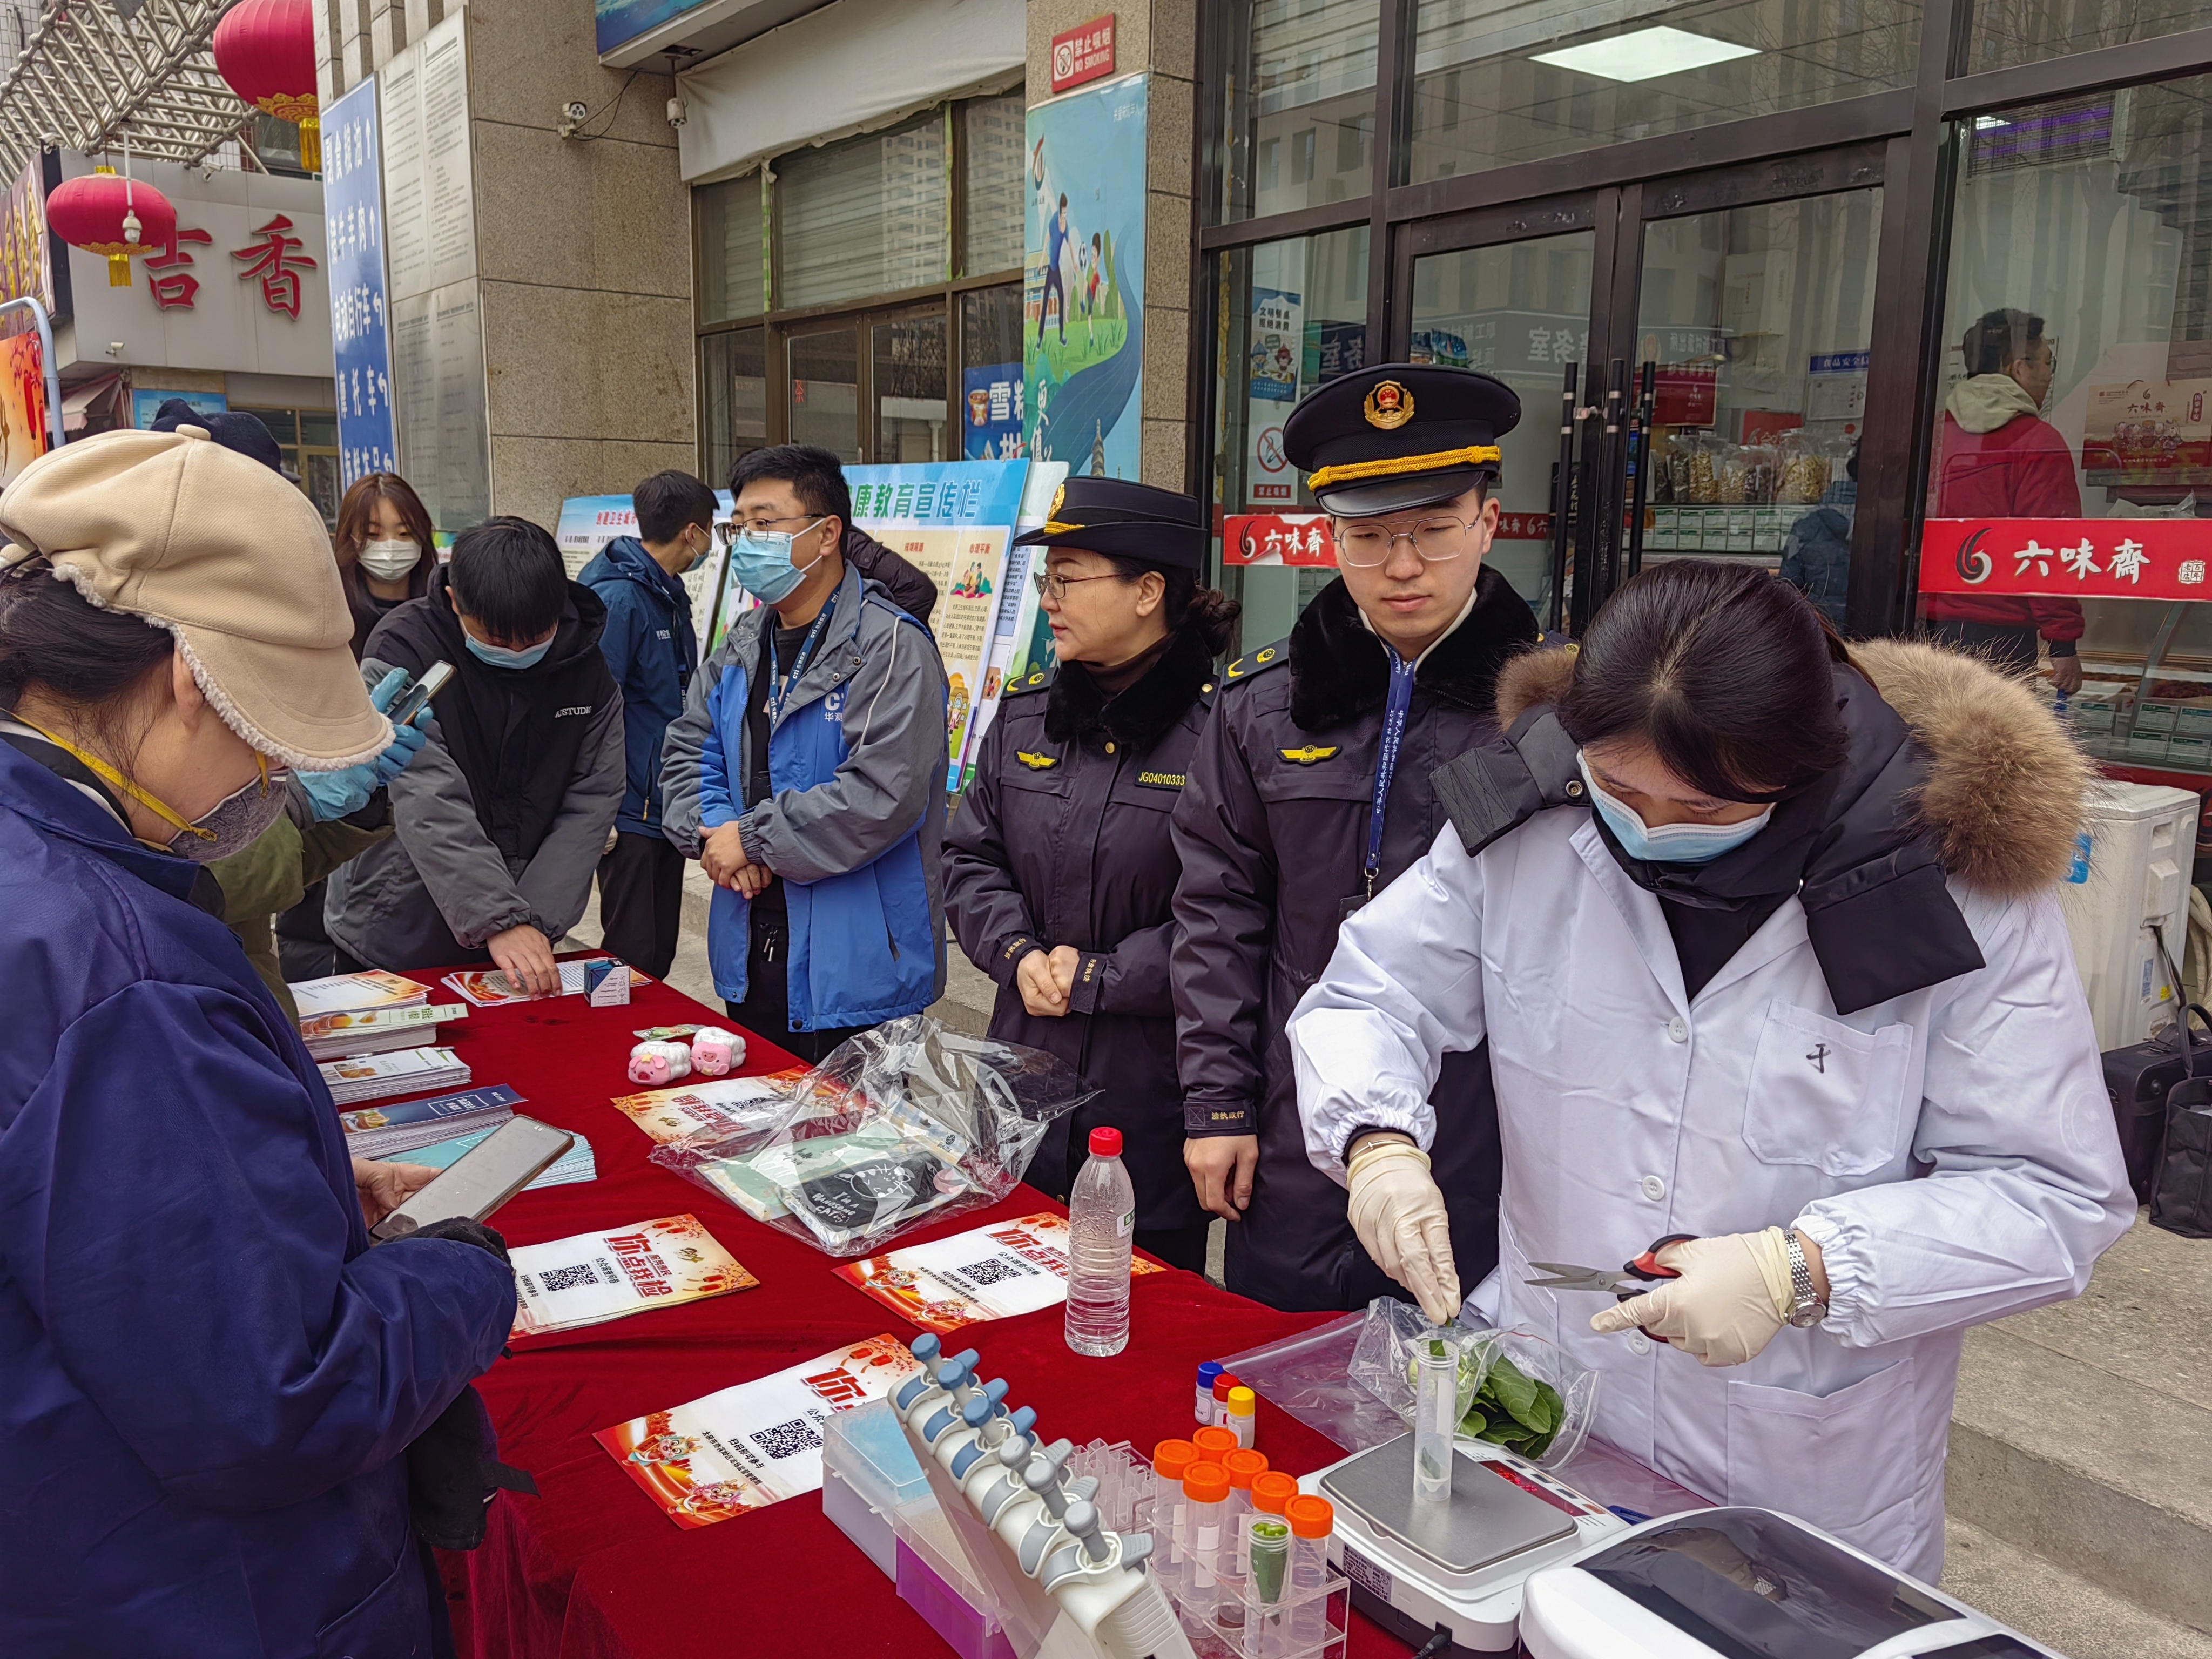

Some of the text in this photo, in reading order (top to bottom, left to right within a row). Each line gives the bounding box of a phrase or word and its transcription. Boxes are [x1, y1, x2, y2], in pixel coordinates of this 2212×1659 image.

[1075, 27, 1110, 58] 禁止吸烟
[1075, 48, 1110, 73] NO SMOKING
[325, 116, 362, 186] 副食粮油
[330, 200, 366, 264] 猪牛羊肉
[334, 283, 371, 341] 电动自行车
[1259, 307, 1290, 320] 文明餐桌
[1259, 318, 1290, 332] 拒绝浪费
[339, 365, 376, 420] 摩托车
[848, 480, 982, 518] 康教育宣传栏
[1258, 486, 1287, 496] 禁止吸烟
[969, 543, 991, 554] 心理平衡
[825, 692, 844, 710] C
[1138, 771, 1186, 786] JG04010333
[815, 1205, 839, 1216] CAT
[603, 1232, 675, 1298] 你点我检
[648, 1254, 672, 1277] 服务惠民
[984, 1228, 1069, 1281] 你点我
[997, 1252, 1042, 1276] 公众调查问卷
[595, 1258, 621, 1284] 公众调查问卷
[941, 1271, 977, 1292] 扫码即可参与
[520, 1275, 538, 1298] 扫码即可参与
[701, 1430, 763, 1486] 太原市杏花岭区市场监督管理局
[727, 1437, 766, 1471] 扫码即可参与
